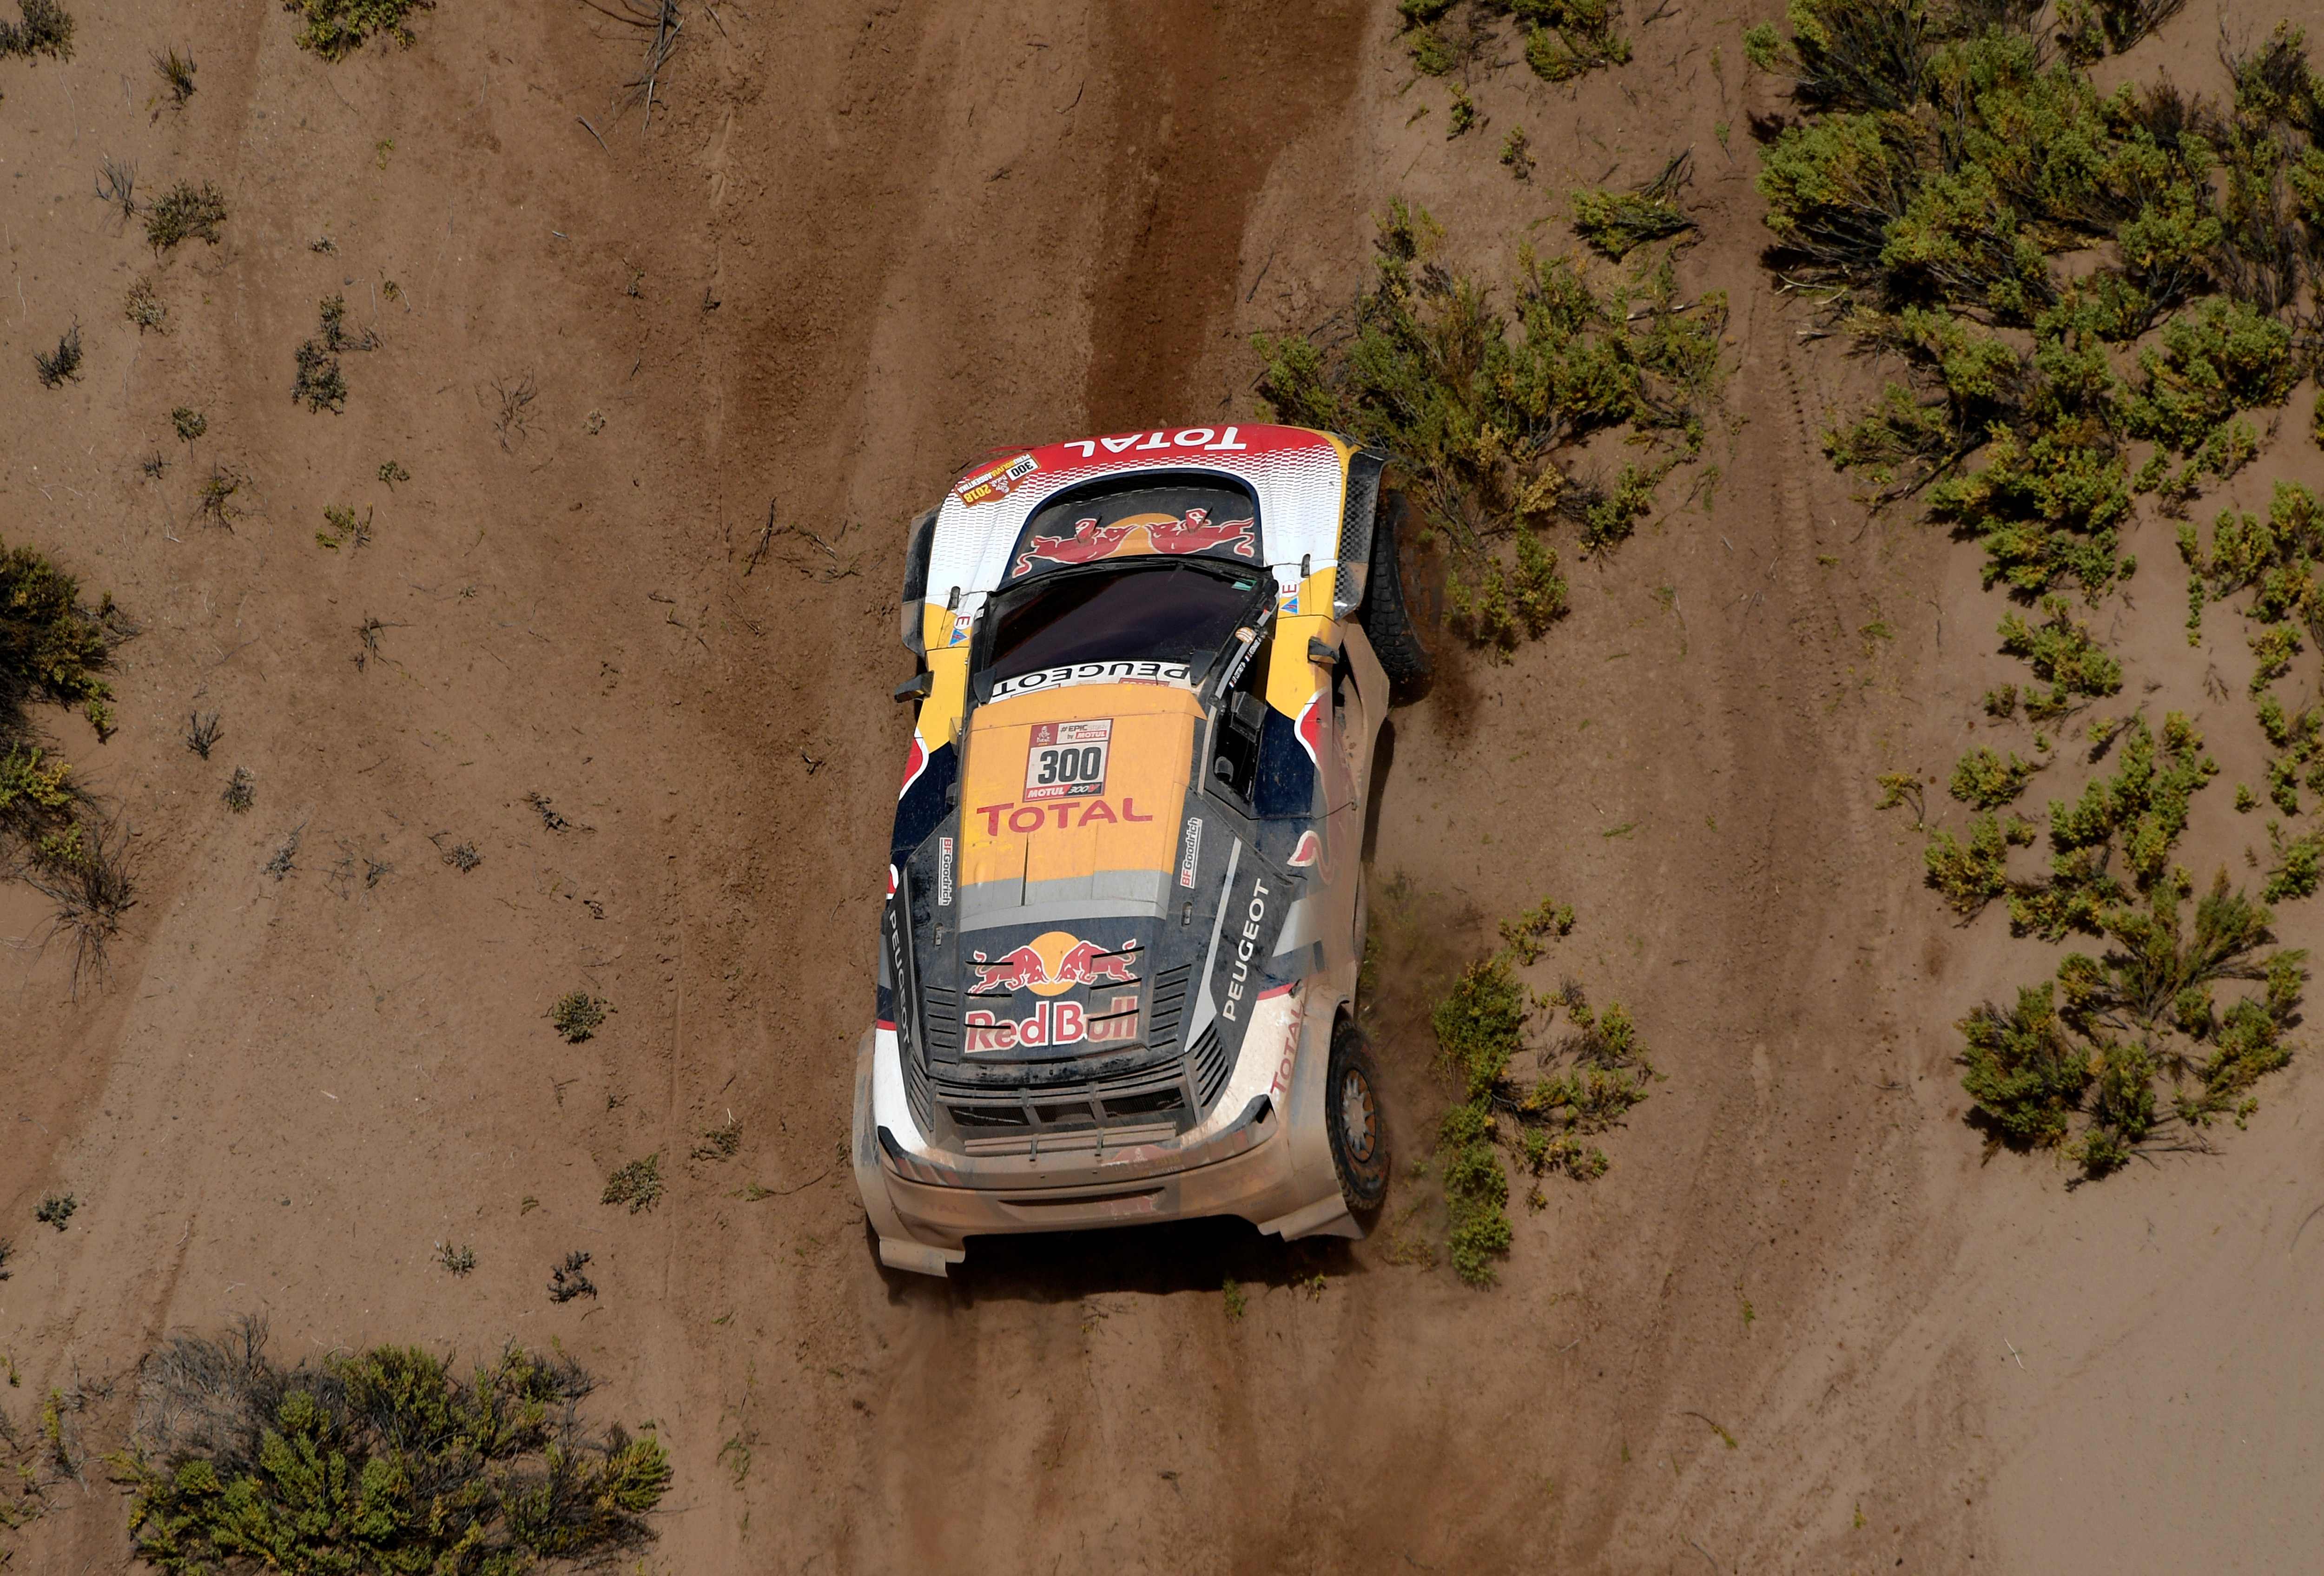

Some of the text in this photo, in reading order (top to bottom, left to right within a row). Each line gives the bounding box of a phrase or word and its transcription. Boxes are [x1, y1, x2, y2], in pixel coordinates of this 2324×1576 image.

[1064, 427, 1247, 457] TOTAL
[1010, 462, 1033, 477] 300
[964, 484, 991, 502] 2018
[993, 663, 1190, 697] PEUGEOT
[1038, 747, 1101, 784] 300
[1027, 787, 1064, 798] MOTUL
[977, 798, 1153, 836] TOTAL
[1181, 818, 1198, 886] BFGoodrich
[943, 839, 951, 904] BFGoodrich
[1222, 878, 1269, 1022] PEUGEOT
[889, 910, 910, 1043] PEUGEOT
[1270, 1000, 1302, 1094] TOTAL
